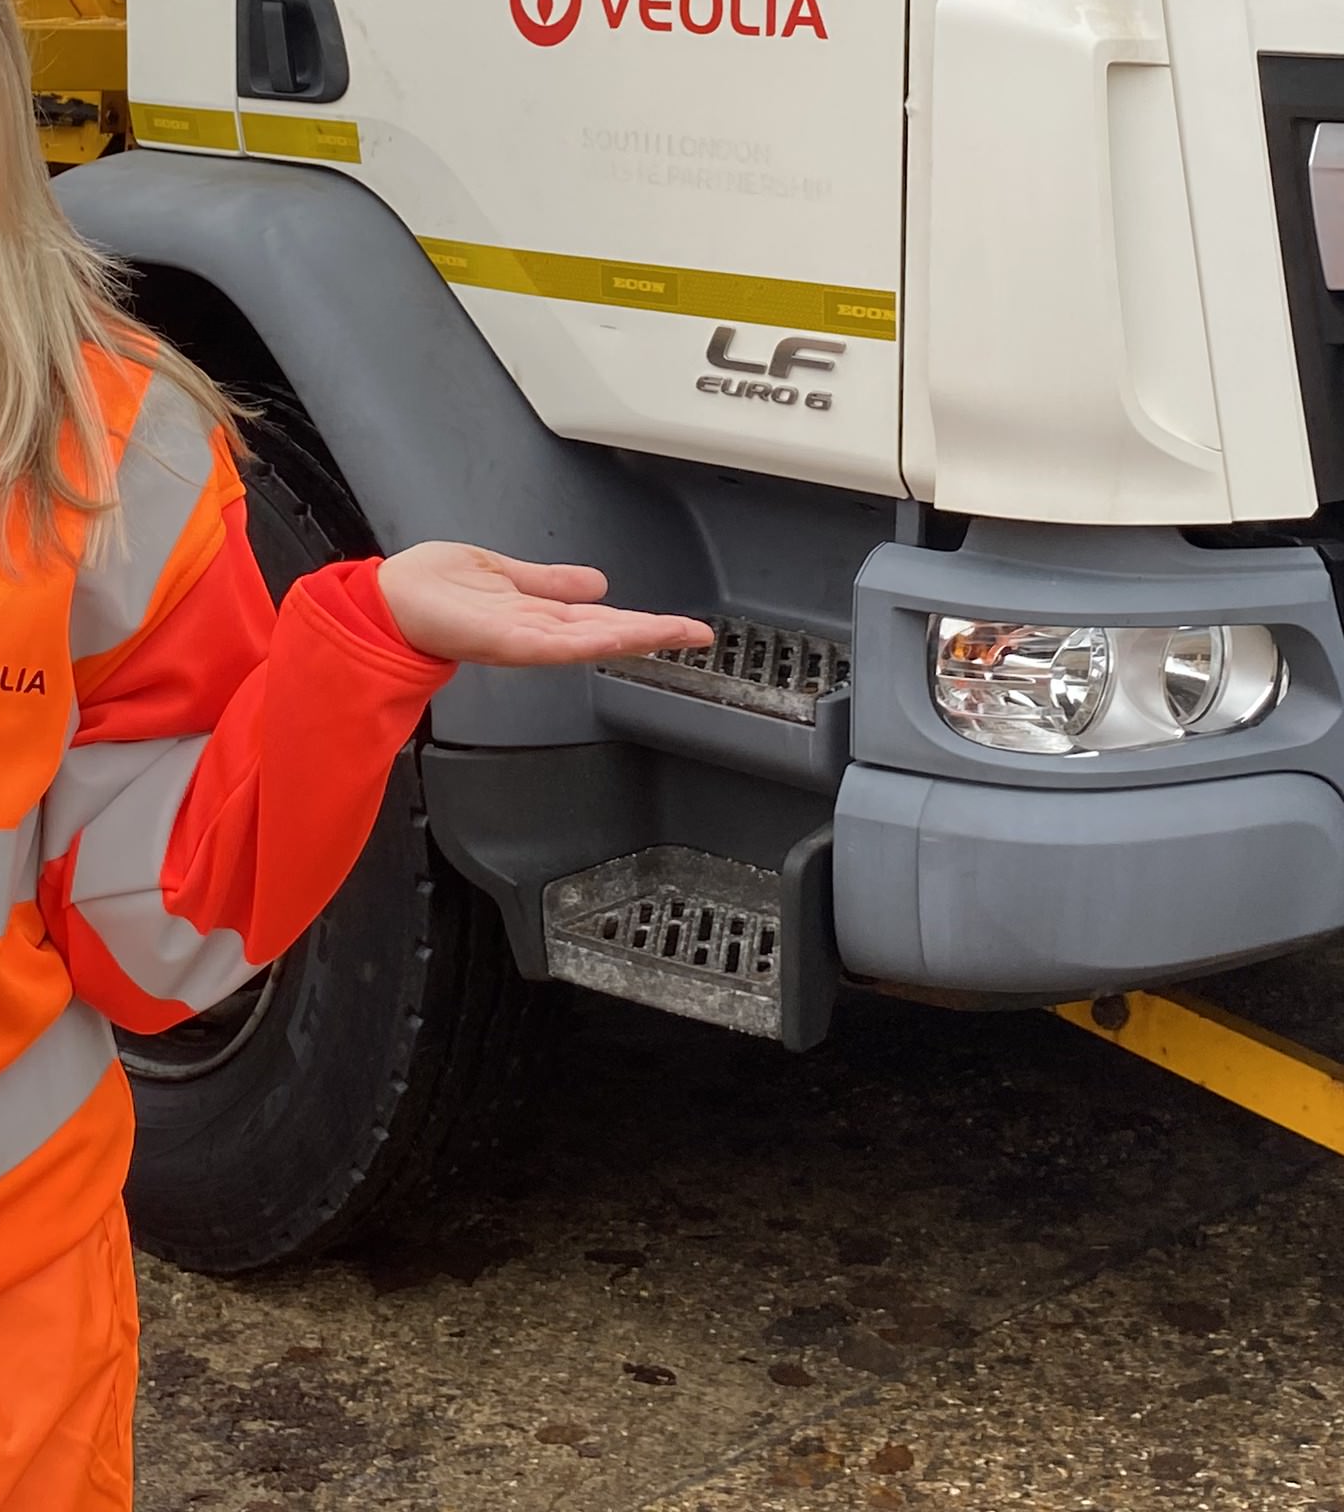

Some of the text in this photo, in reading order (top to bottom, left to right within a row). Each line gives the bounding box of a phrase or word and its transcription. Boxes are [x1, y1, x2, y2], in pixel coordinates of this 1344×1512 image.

[613, 277, 665, 293] ECON
[705, 325, 847, 379] LF
[695, 375, 833, 411] EURO 6
